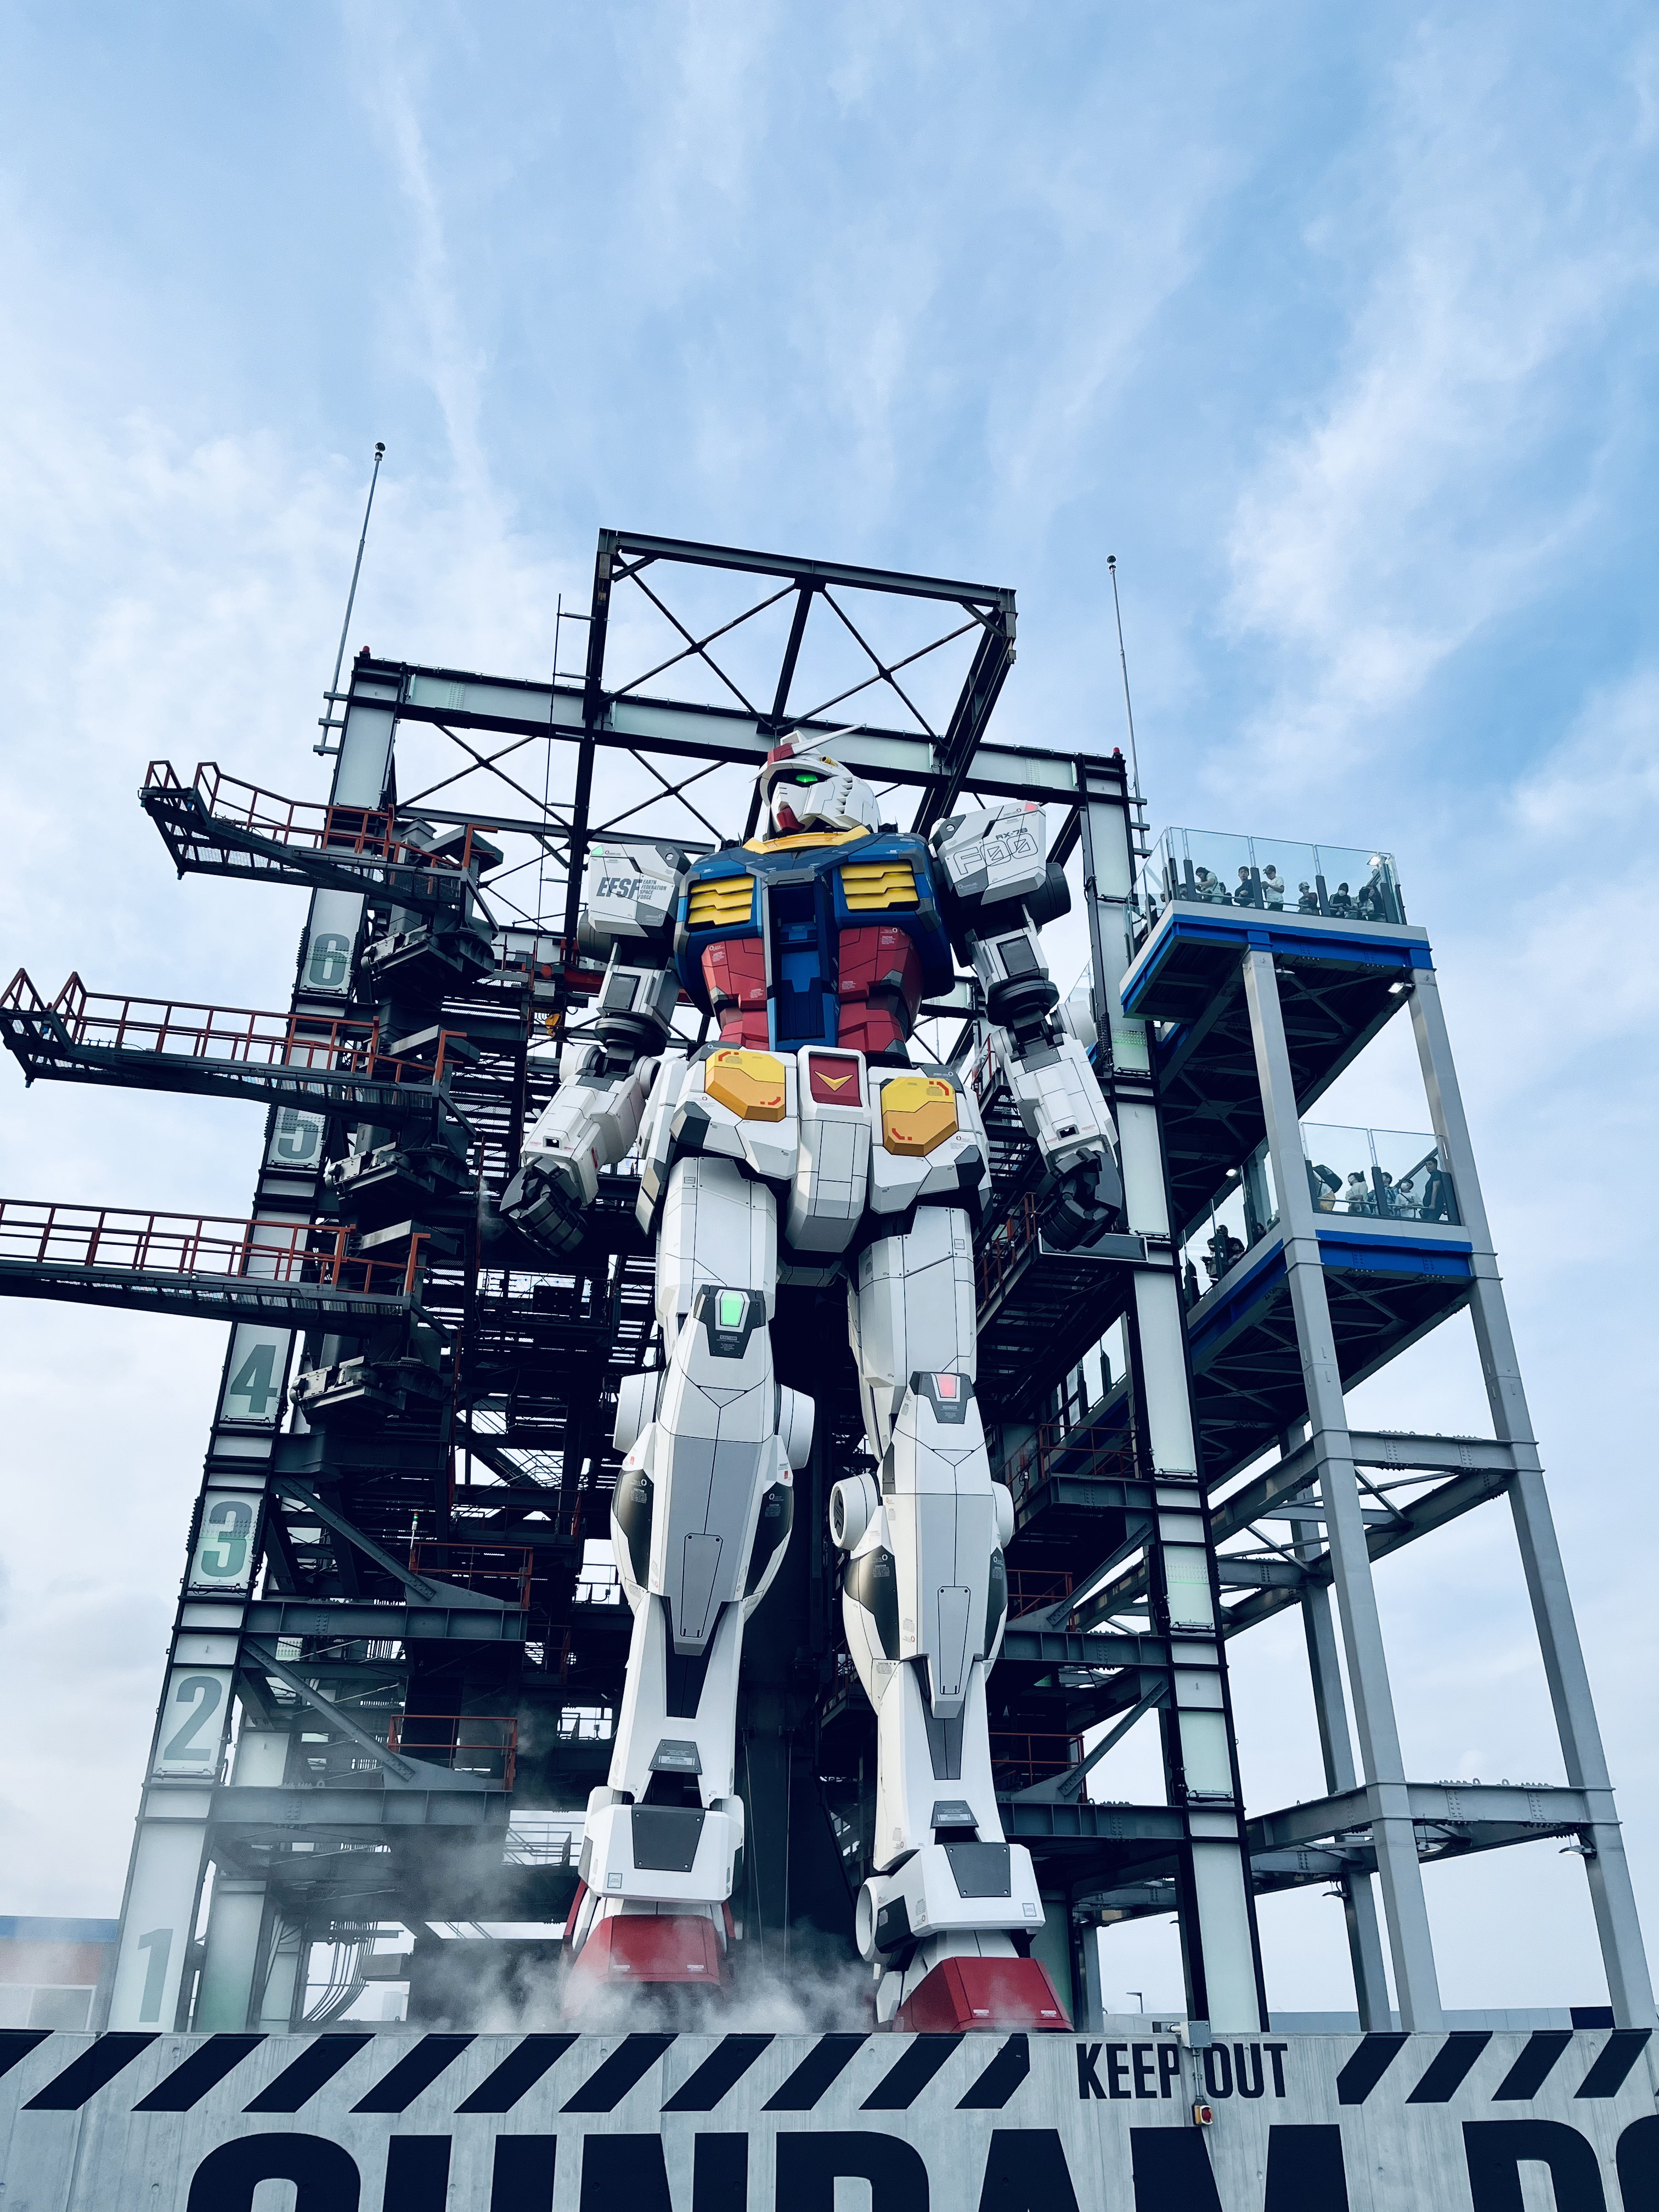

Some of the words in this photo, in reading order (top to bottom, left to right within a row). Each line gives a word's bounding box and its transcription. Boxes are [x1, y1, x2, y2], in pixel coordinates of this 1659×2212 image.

[996, 827, 1028, 840] RX-78
[596, 877, 642, 898] EFSF
[309, 933, 350, 986] 6
[277, 1107, 319, 1160] 5
[229, 1344, 278, 1413] 4
[200, 1500, 253, 1577] 3
[164, 1675, 223, 1761] 2
[137, 1928, 174, 2023] 1
[1076, 2042, 1181, 2100] KEEP
[1204, 2042, 1288, 2099] OUT
